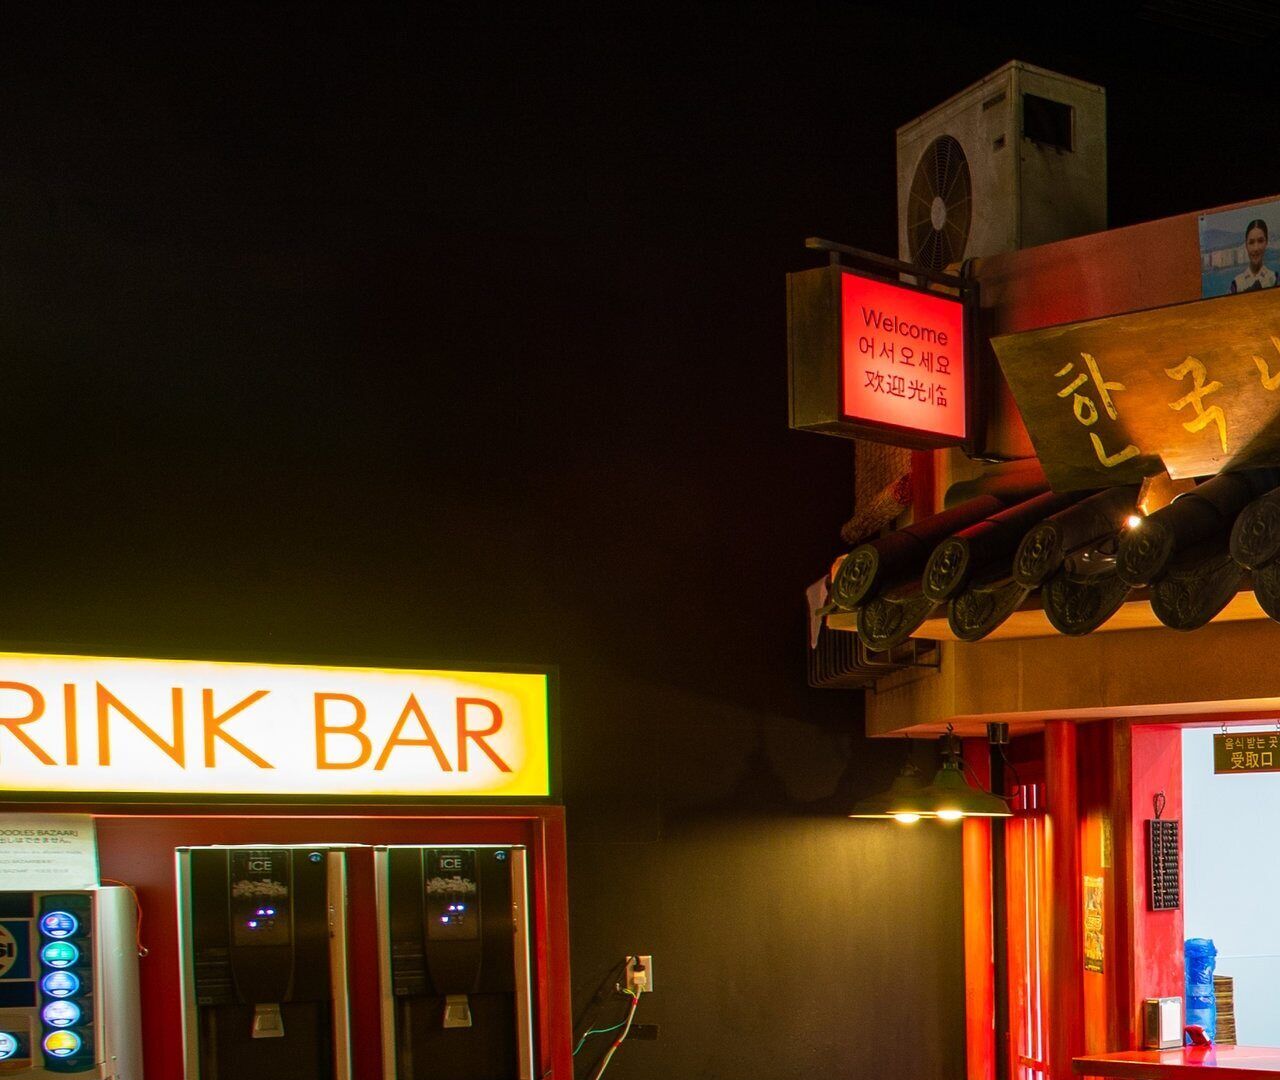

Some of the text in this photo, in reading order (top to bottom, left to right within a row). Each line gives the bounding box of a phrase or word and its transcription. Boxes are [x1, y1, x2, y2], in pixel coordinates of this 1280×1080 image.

[861, 306, 949, 348] Welcome
[857, 335, 952, 376] 어서오세요
[863, 369, 949, 408] 欢迎光临
[312, 692, 514, 774] BAR
[1230, 751, 1273, 770] 受取口
[248, 860, 272, 871] ICE
[440, 858, 462, 869] ICE
